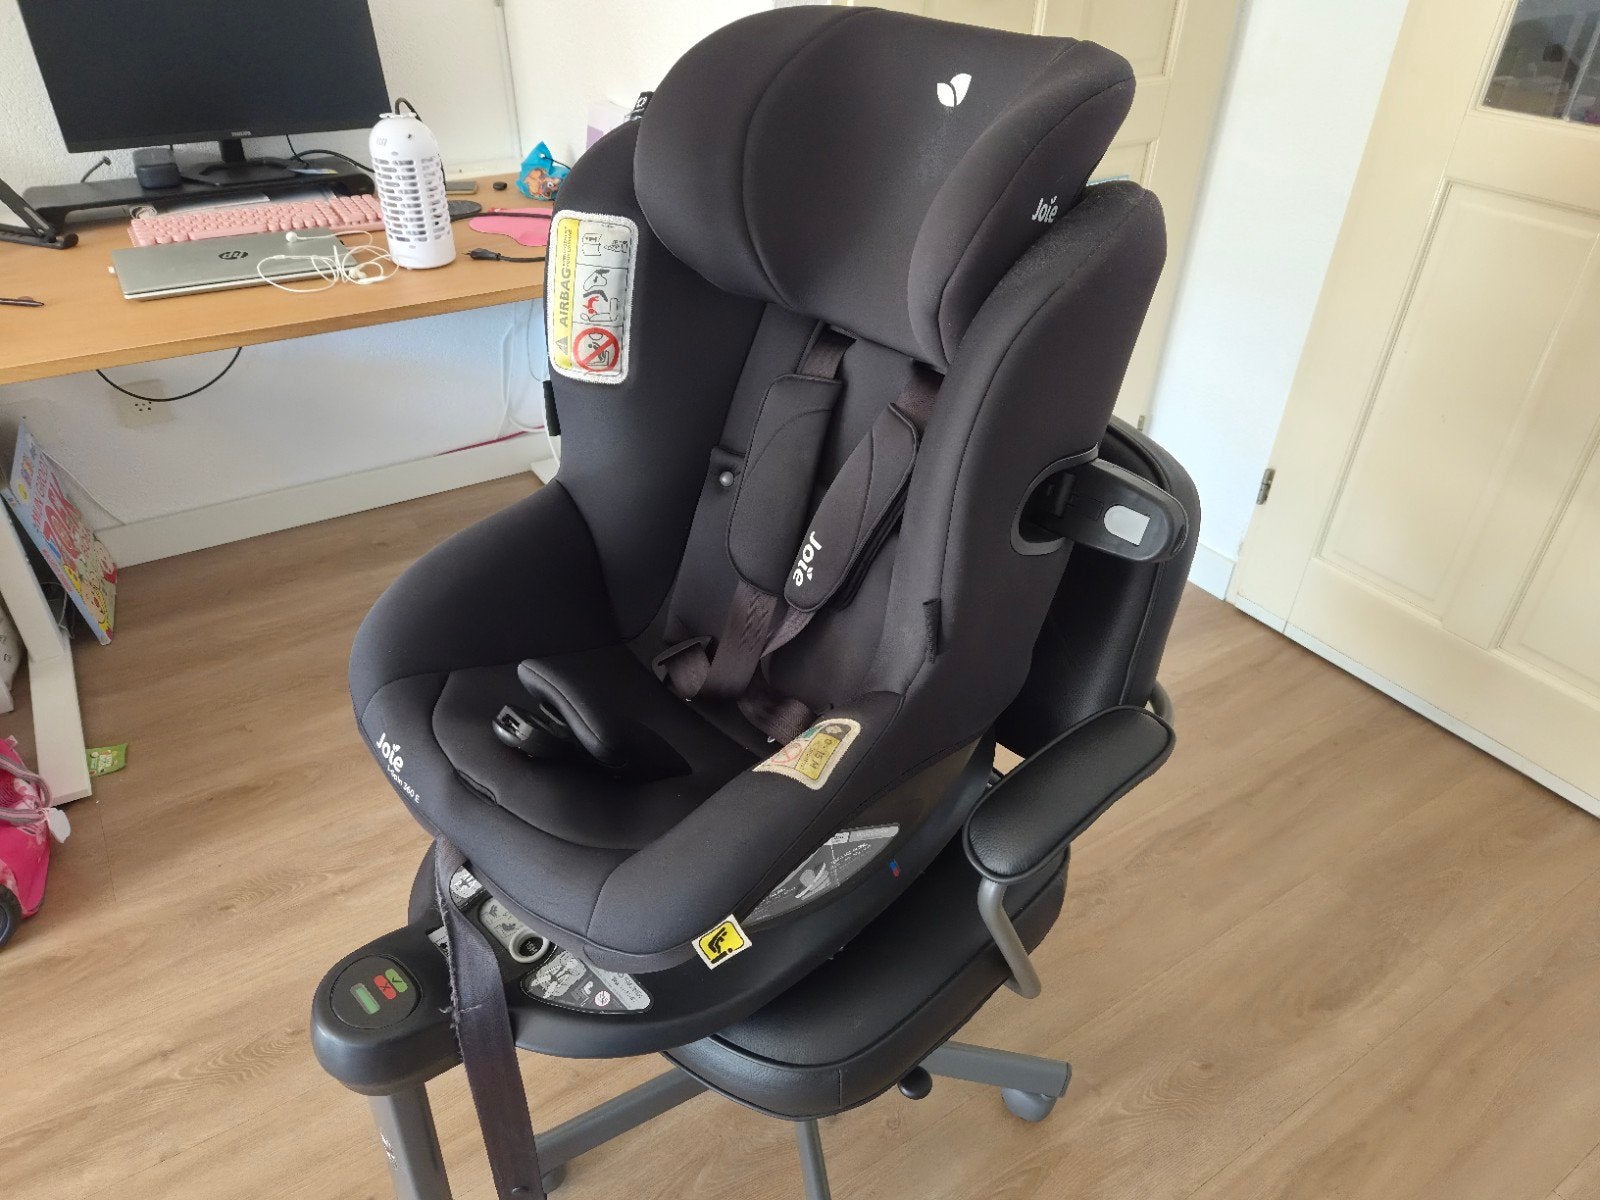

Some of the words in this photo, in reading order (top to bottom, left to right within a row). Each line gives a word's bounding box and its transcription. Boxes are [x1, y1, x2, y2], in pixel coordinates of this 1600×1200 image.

[1031, 196, 1059, 223] Joie
[559, 267, 572, 328] AIRBAG
[792, 531, 823, 587] Joie
[375, 732, 404, 773] Joie
[402, 781, 415, 798] 360
[414, 793, 421, 804] E
